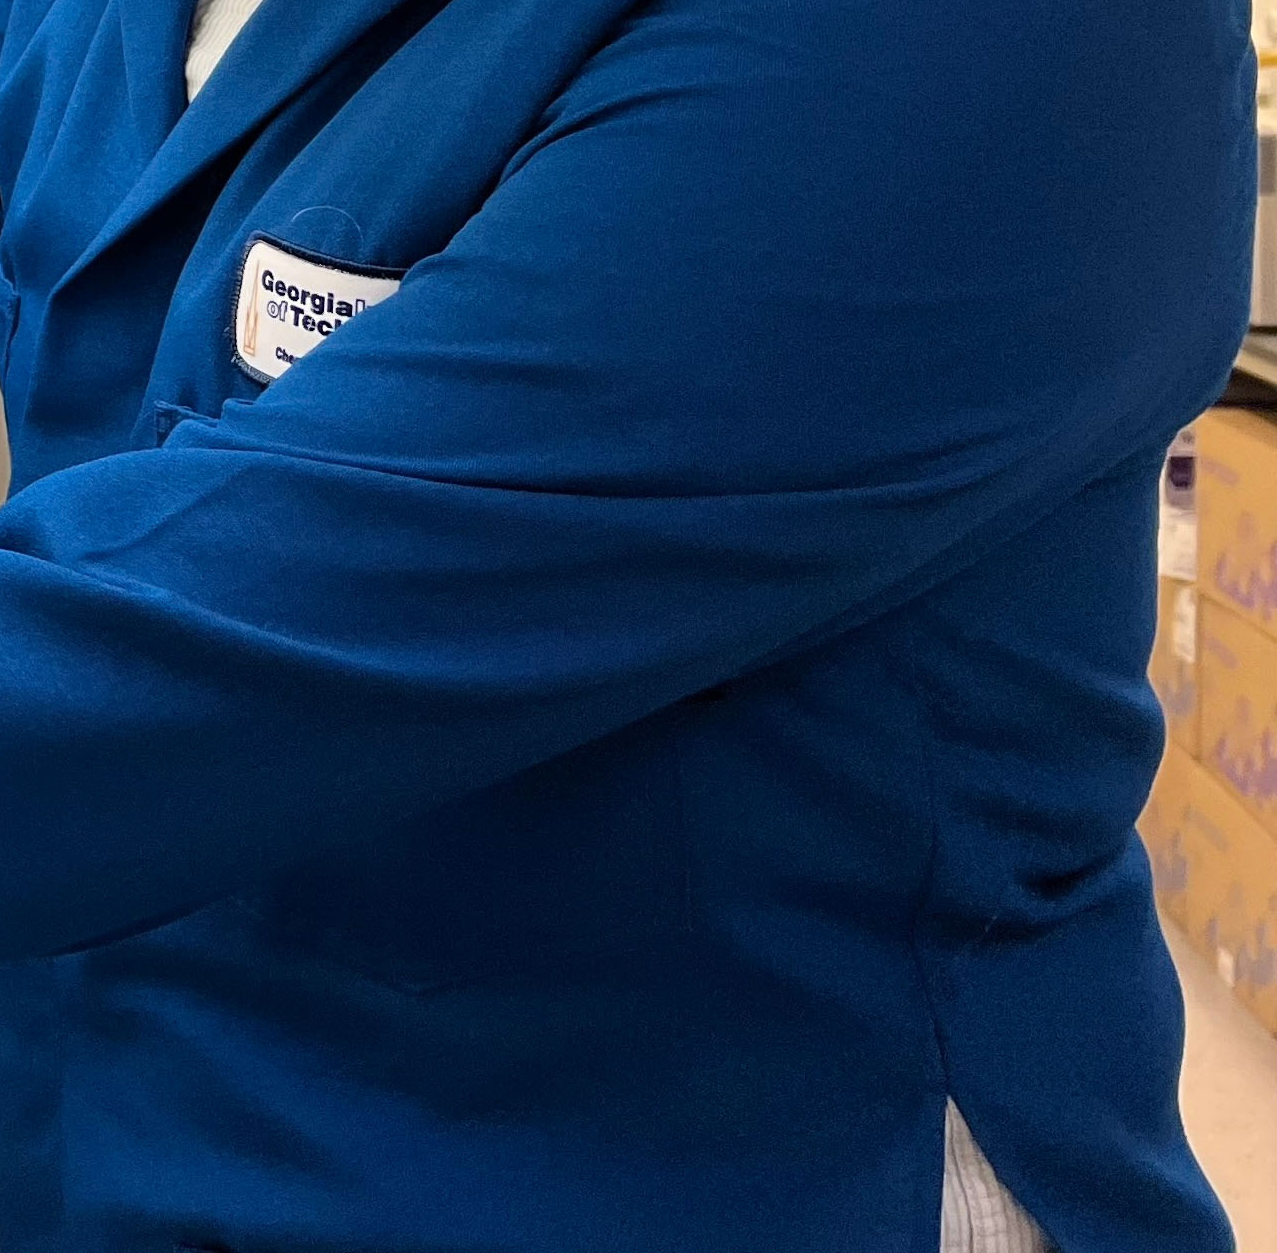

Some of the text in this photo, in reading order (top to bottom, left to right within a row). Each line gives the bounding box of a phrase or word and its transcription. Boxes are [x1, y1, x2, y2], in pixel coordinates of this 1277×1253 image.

[261, 269, 354, 318] Georgia
[266, 300, 289, 322] of
[275, 346, 302, 365] Che
